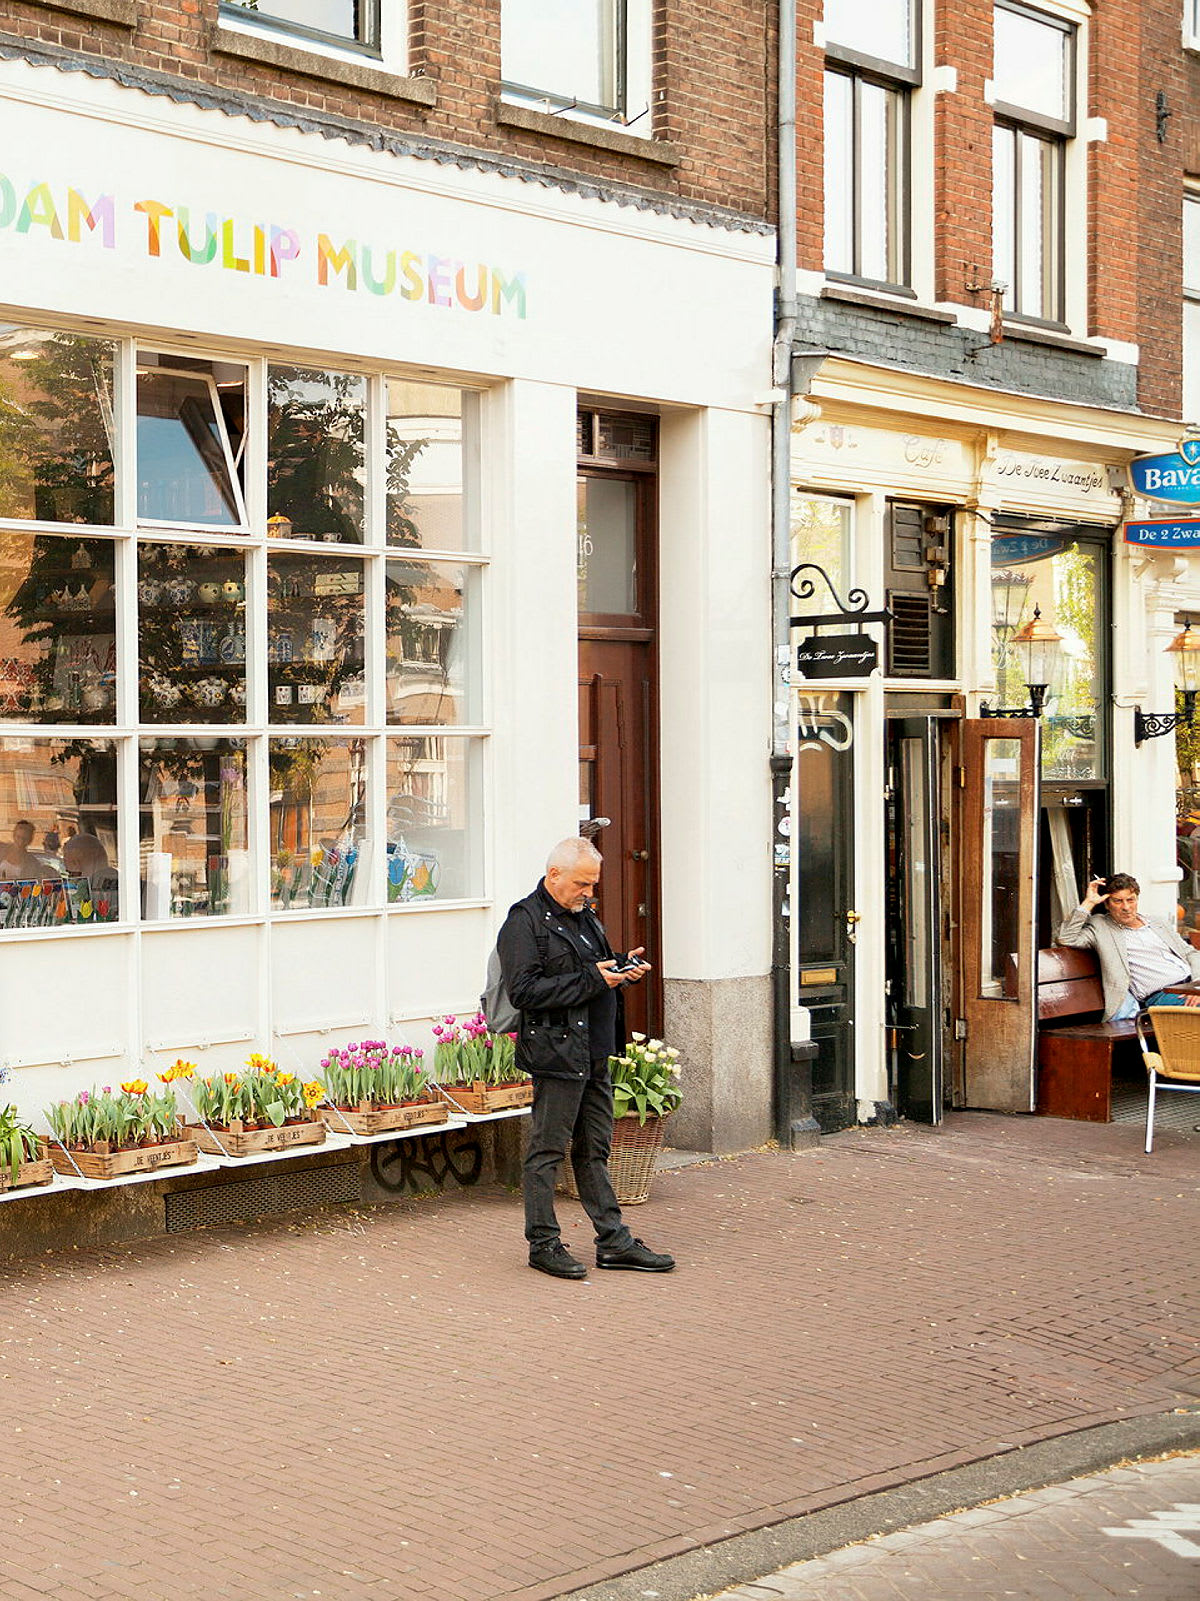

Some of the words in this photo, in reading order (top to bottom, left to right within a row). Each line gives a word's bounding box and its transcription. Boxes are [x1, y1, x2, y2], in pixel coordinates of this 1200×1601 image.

[133, 199, 300, 278] TULIP
[317, 233, 527, 319] MUSEUM
[1144, 468, 1200, 490] Bava
[1139, 529, 1157, 541] De
[1160, 529, 1169, 540] 2
